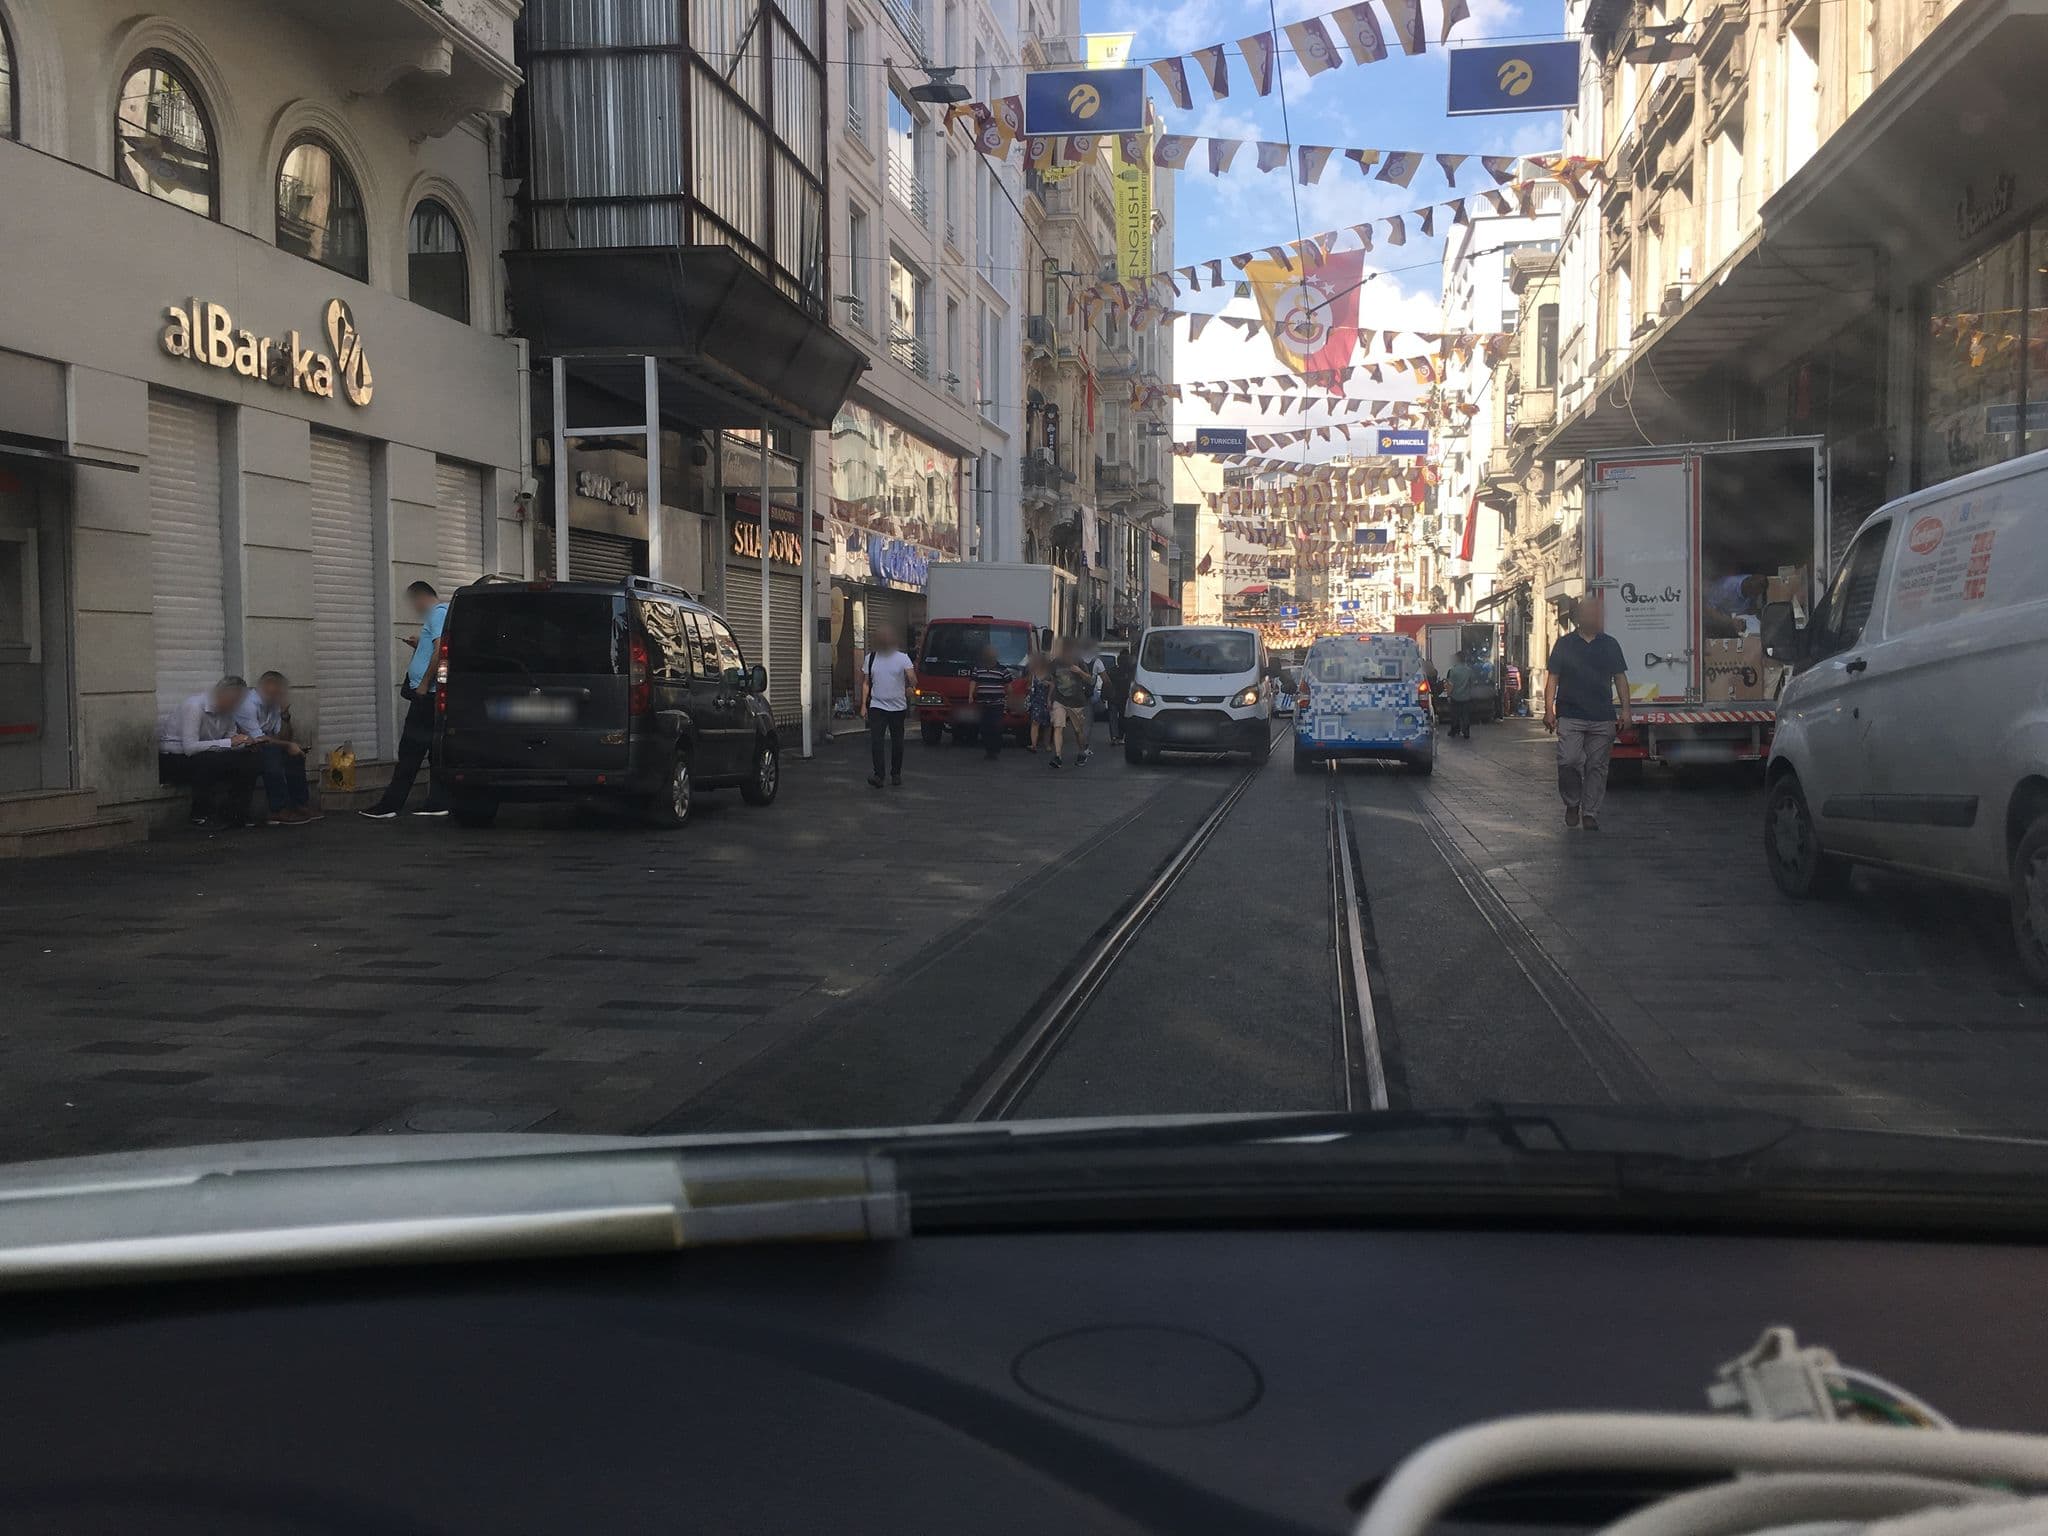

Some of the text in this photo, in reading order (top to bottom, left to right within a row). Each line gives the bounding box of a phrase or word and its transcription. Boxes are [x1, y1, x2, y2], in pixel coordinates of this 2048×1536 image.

[1128, 186, 1140, 278] ENGLISH
[161, 296, 334, 399] alBaraka
[1647, 713, 1666, 723] 55
